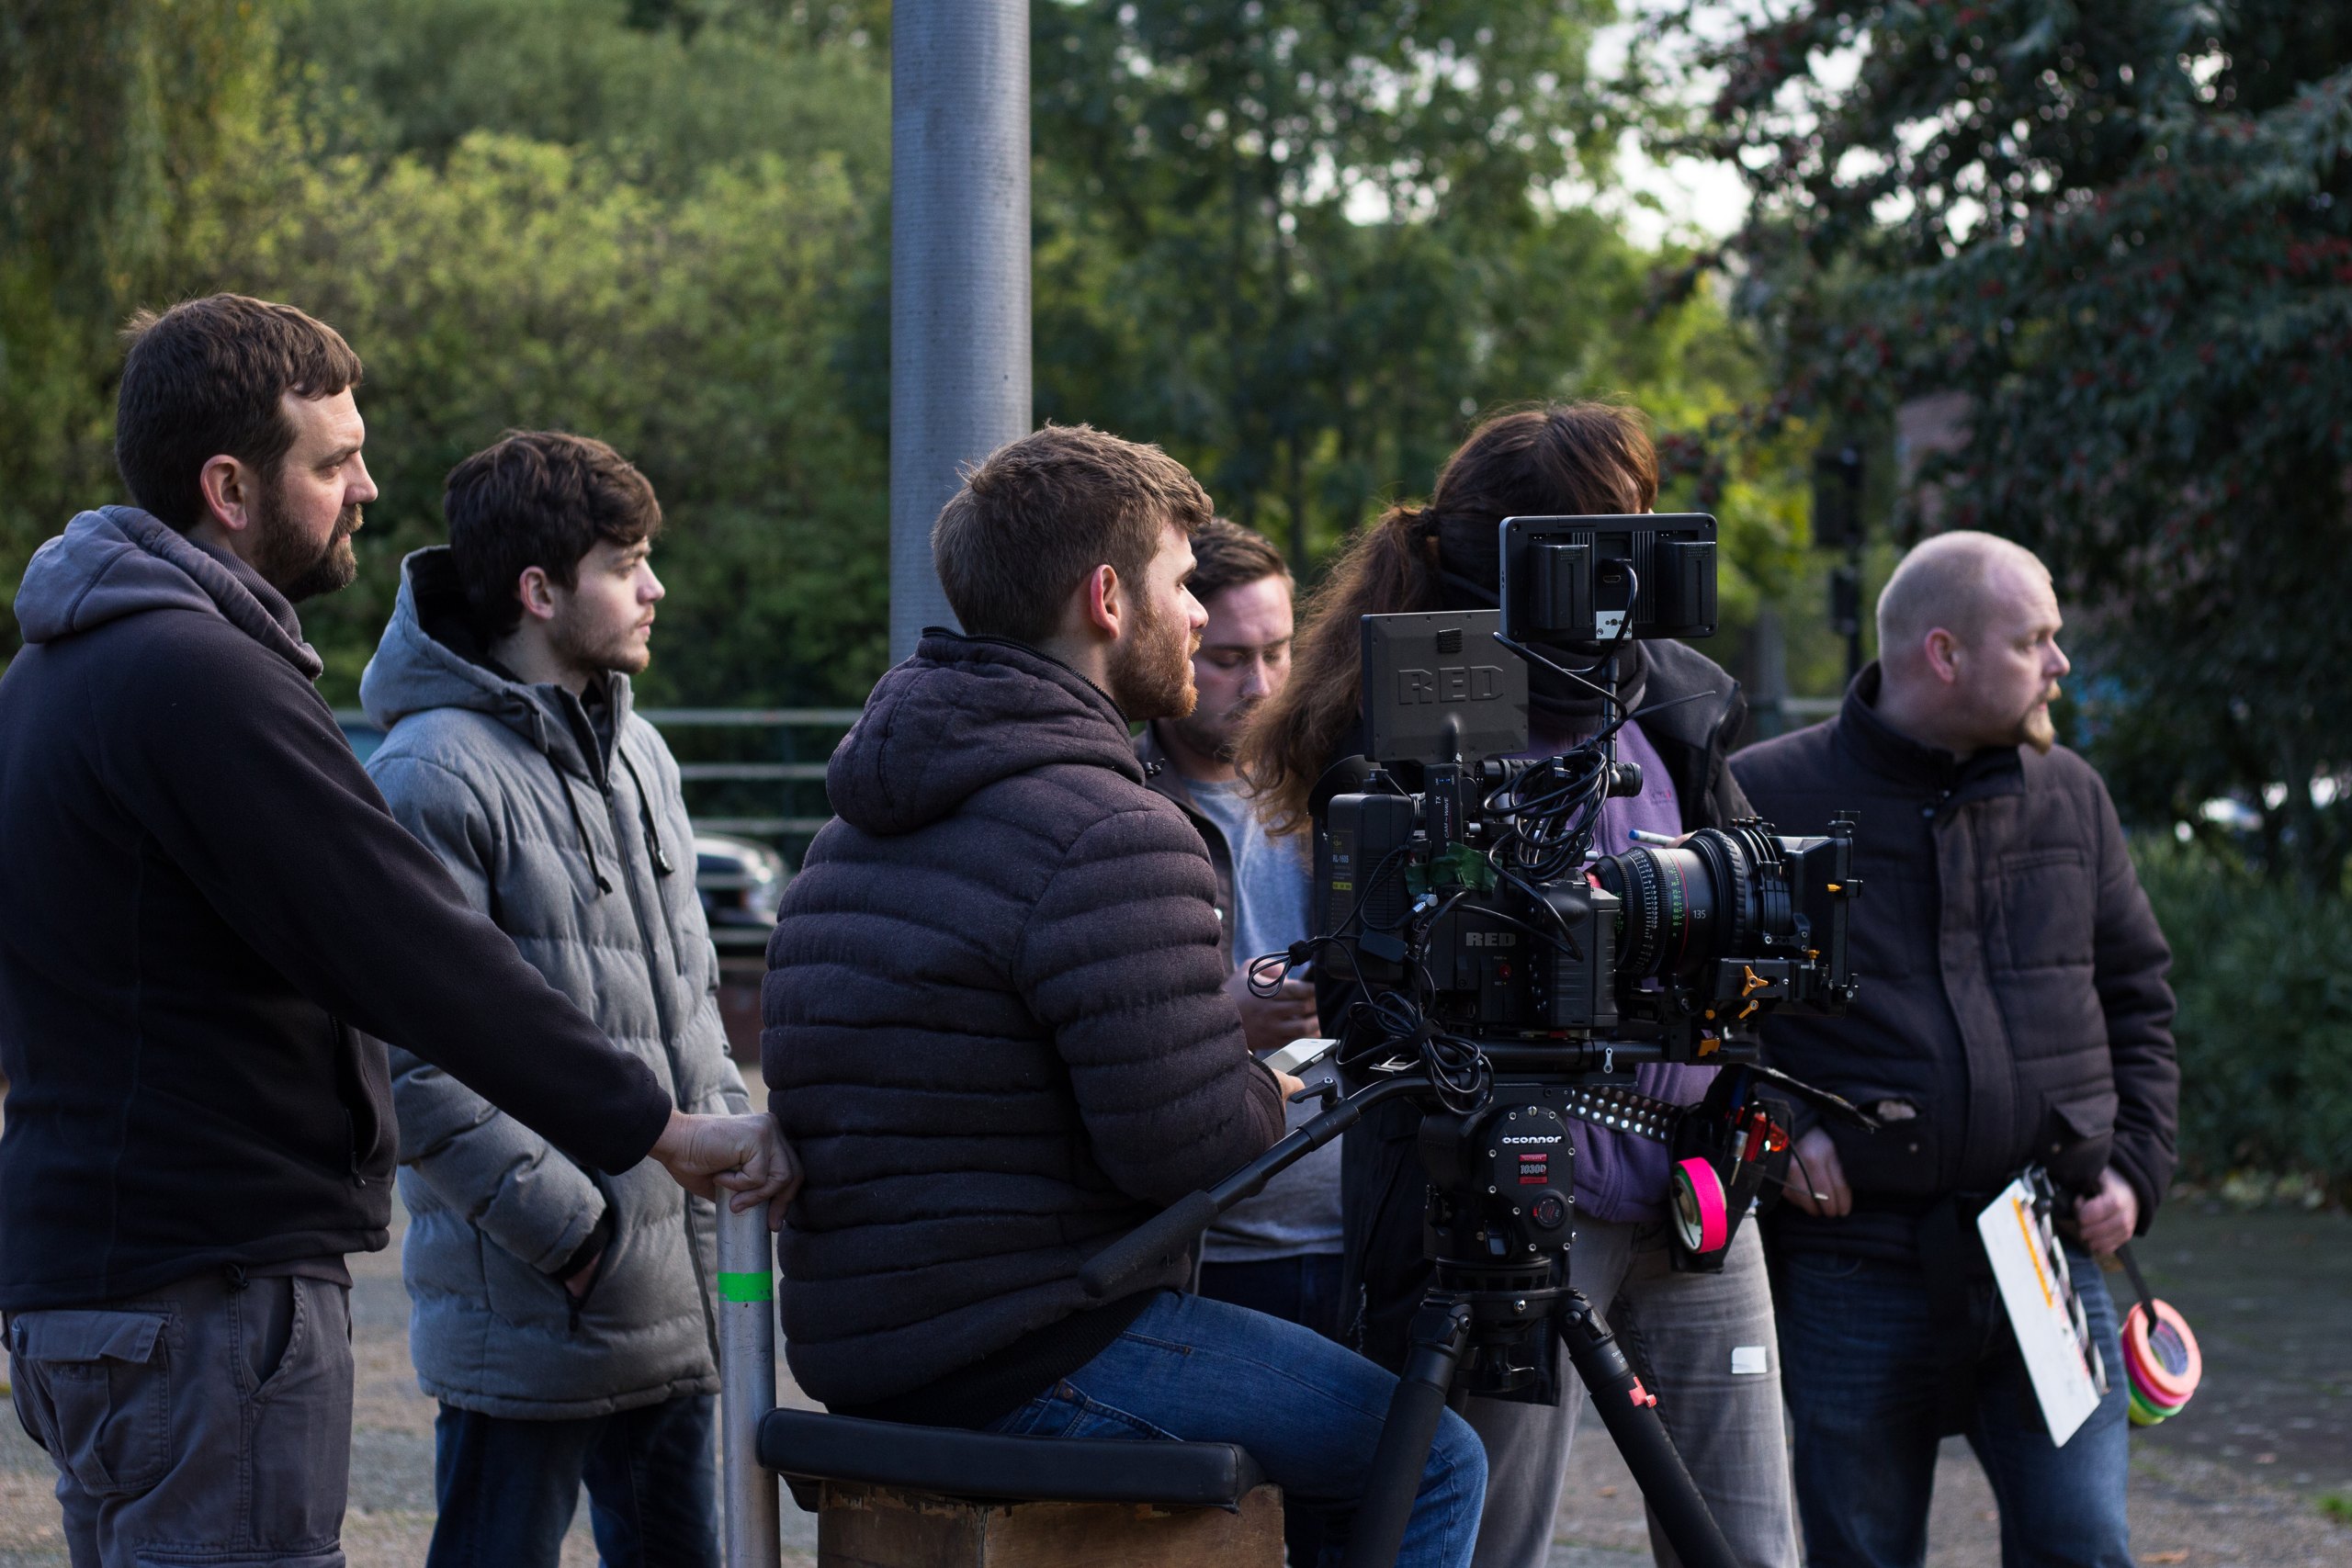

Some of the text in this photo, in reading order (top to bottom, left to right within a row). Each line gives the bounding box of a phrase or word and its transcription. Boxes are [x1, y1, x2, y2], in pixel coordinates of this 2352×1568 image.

[1397, 664, 1505, 705] RED
[1435, 795, 1442, 805] TX
[1692, 909, 1706, 919] 135
[1465, 931, 1516, 947] RED
